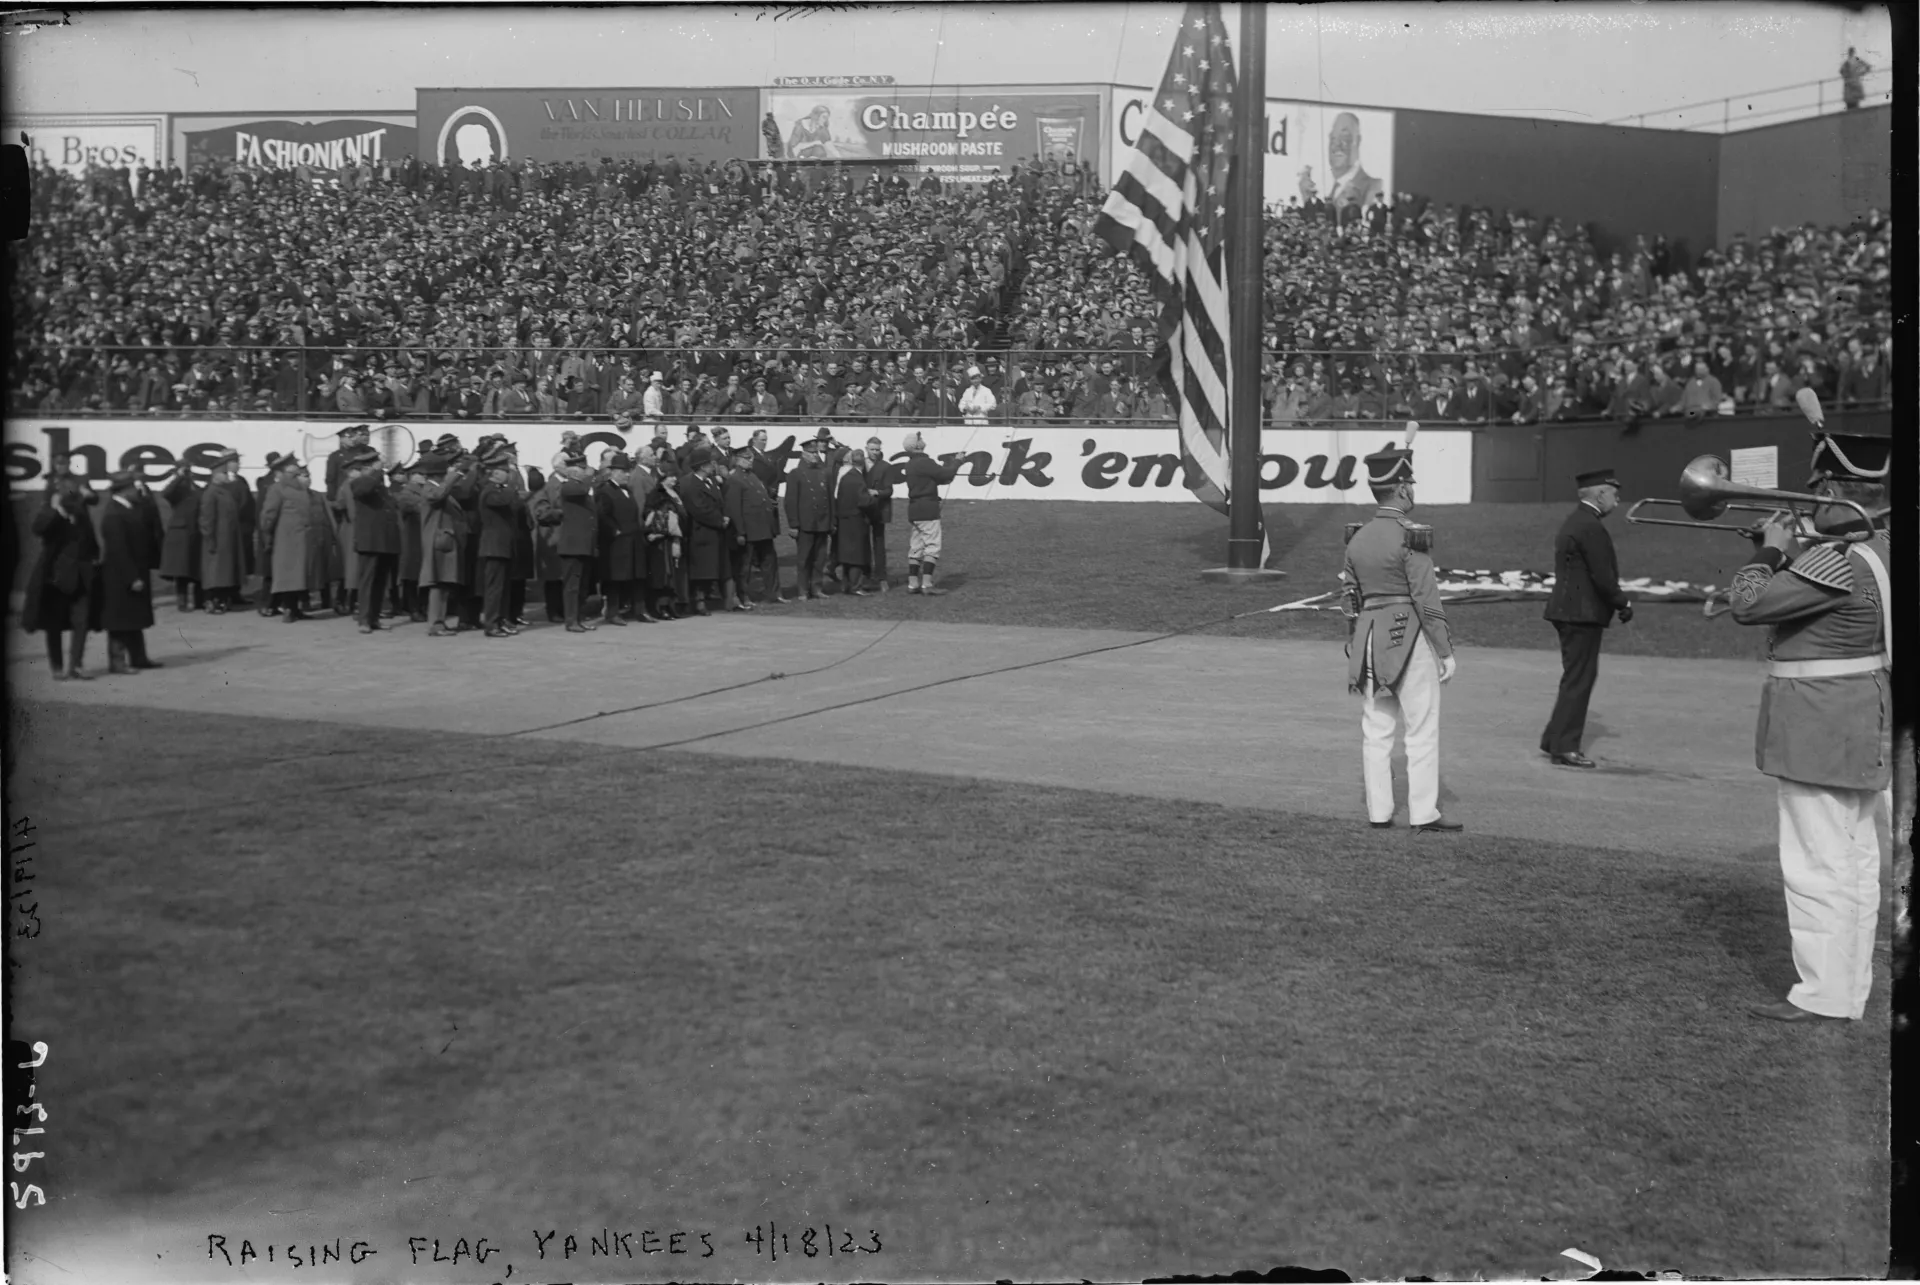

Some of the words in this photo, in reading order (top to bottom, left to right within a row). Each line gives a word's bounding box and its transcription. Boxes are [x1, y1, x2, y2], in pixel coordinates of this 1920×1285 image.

[540, 97, 602, 122] VAN
[612, 97, 737, 122] HEUSEN
[652, 126, 732, 144] COLLAR
[235, 127, 387, 171] FASHIONKNIT
[882, 142, 958, 156] MUSHROOM
[961, 142, 1003, 156] PASTE
[1260, 440, 1396, 490] ou
